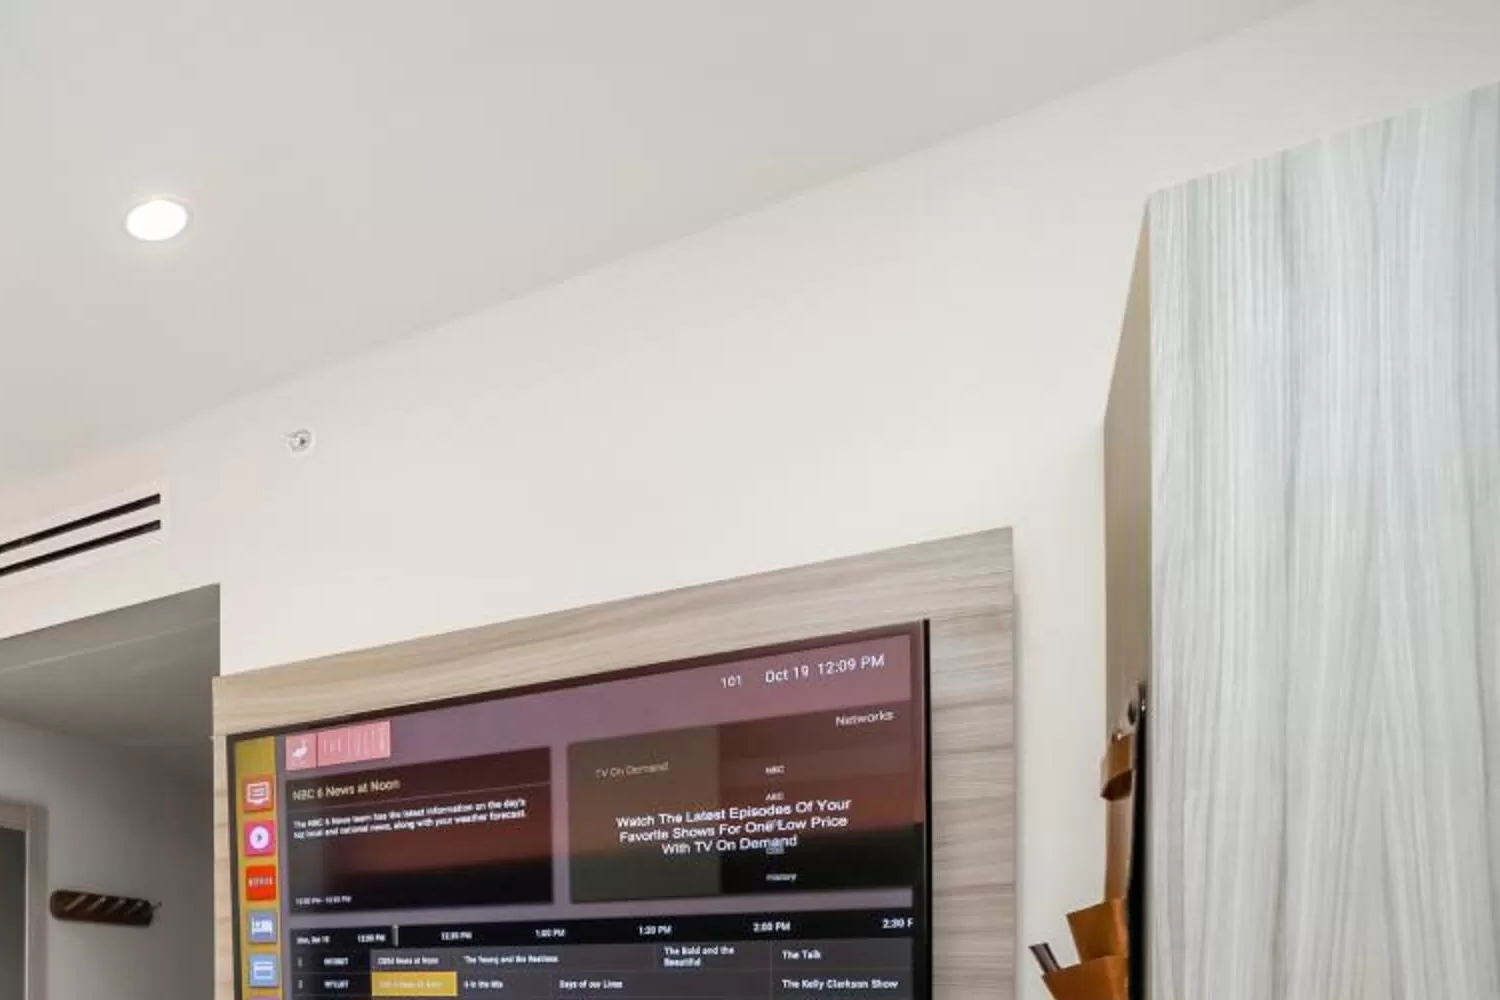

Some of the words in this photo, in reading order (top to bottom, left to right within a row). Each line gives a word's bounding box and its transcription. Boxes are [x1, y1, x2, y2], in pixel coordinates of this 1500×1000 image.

[765, 668, 789, 683] Oct
[794, 665, 809, 679] 19
[818, 659, 856, 675] 12:09
[860, 654, 885, 669] PM
[720, 675, 742, 688] 101
[835, 710, 895, 727] Networks
[610, 766, 624, 777] On
[625, 761, 669, 775] Demand
[292, 789, 316, 800] NBC
[317, 788, 324, 799] 6
[326, 785, 355, 797] News
[357, 783, 368, 793] at
[370, 779, 400, 791] Noon
[616, 815, 655, 828] Watch
[658, 812, 683, 824] The
[685, 809, 726, 822] Latest
[729, 804, 792, 820] Episodes
[795, 801, 813, 813] Of
[816, 799, 852, 812] Your
[619, 830, 669, 843] Favorite
[672, 827, 715, 839] Shows
[720, 823, 742, 835] For
[745, 820, 774, 833] One
[778, 819, 807, 831] Low
[811, 816, 848, 828] Price
[661, 842, 691, 855] With
[694, 840, 713, 853] TV
[716, 838, 737, 851] On
[739, 833, 798, 850] Demand
[657, 925, 672, 934] PM
[775, 921, 791, 931] PM
[882, 918, 905, 928] 2:30
[553, 928, 565, 937] PM
[664, 946, 680, 955] The
[702, 946, 719, 955] and
[720, 945, 735, 955] the
[781, 950, 799, 960] The
[801, 949, 822, 960] Talk
[781, 978, 800, 989] The
[801, 978, 825, 990] Kelly
[826, 978, 869, 989] Clarkson
[871, 978, 899, 989] Show
